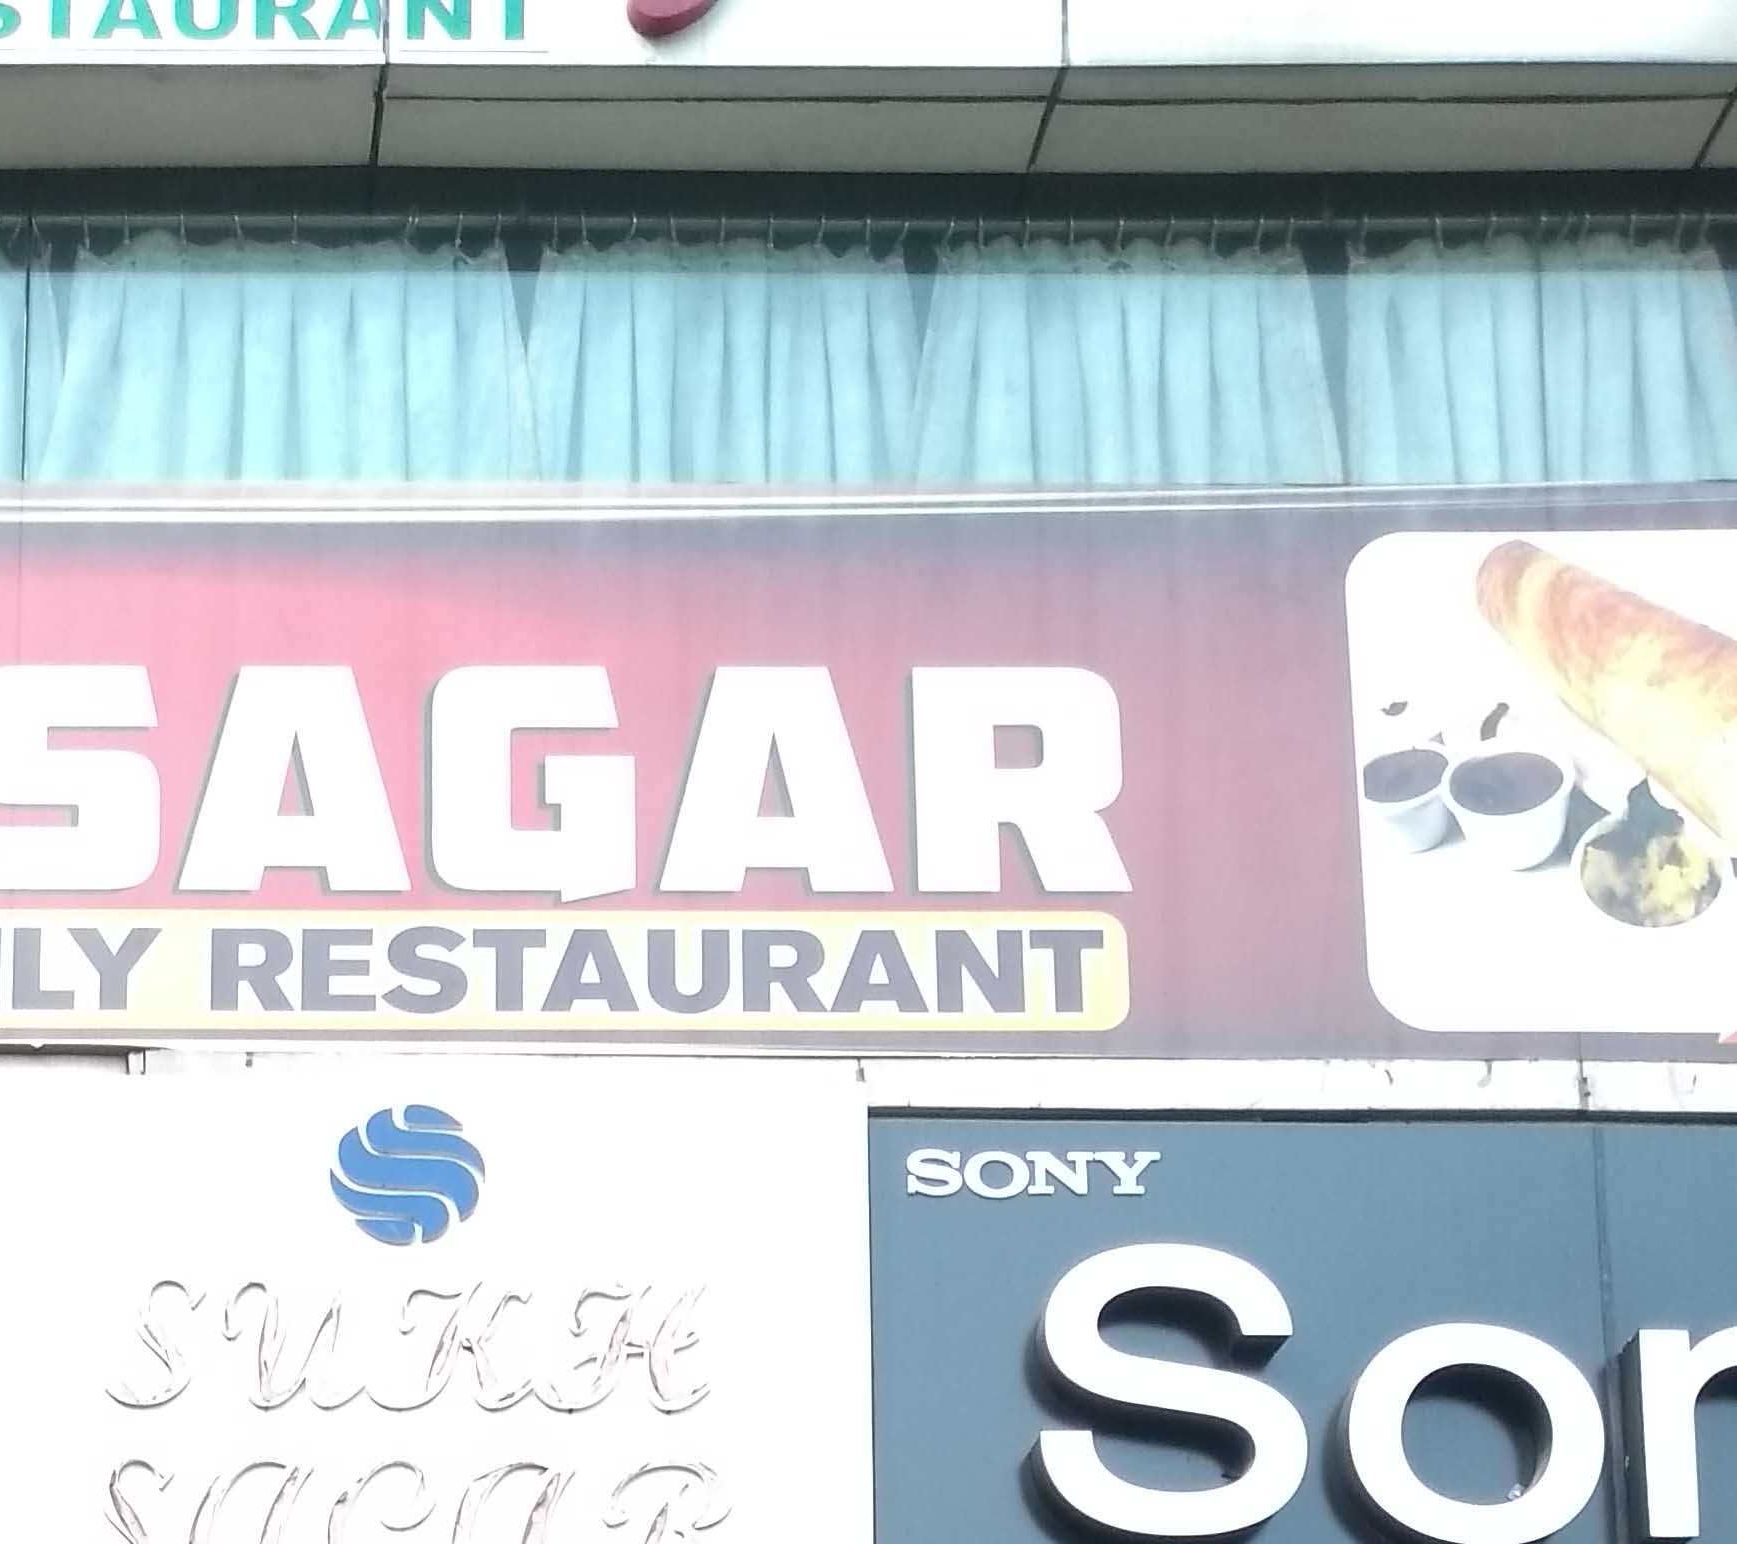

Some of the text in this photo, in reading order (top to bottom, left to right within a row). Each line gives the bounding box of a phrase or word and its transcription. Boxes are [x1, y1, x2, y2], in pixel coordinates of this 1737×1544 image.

[208, 924, 1105, 1016] RESTAURANT
[906, 1148, 1161, 1199] SONY
[104, 1279, 713, 1415] SUKH
